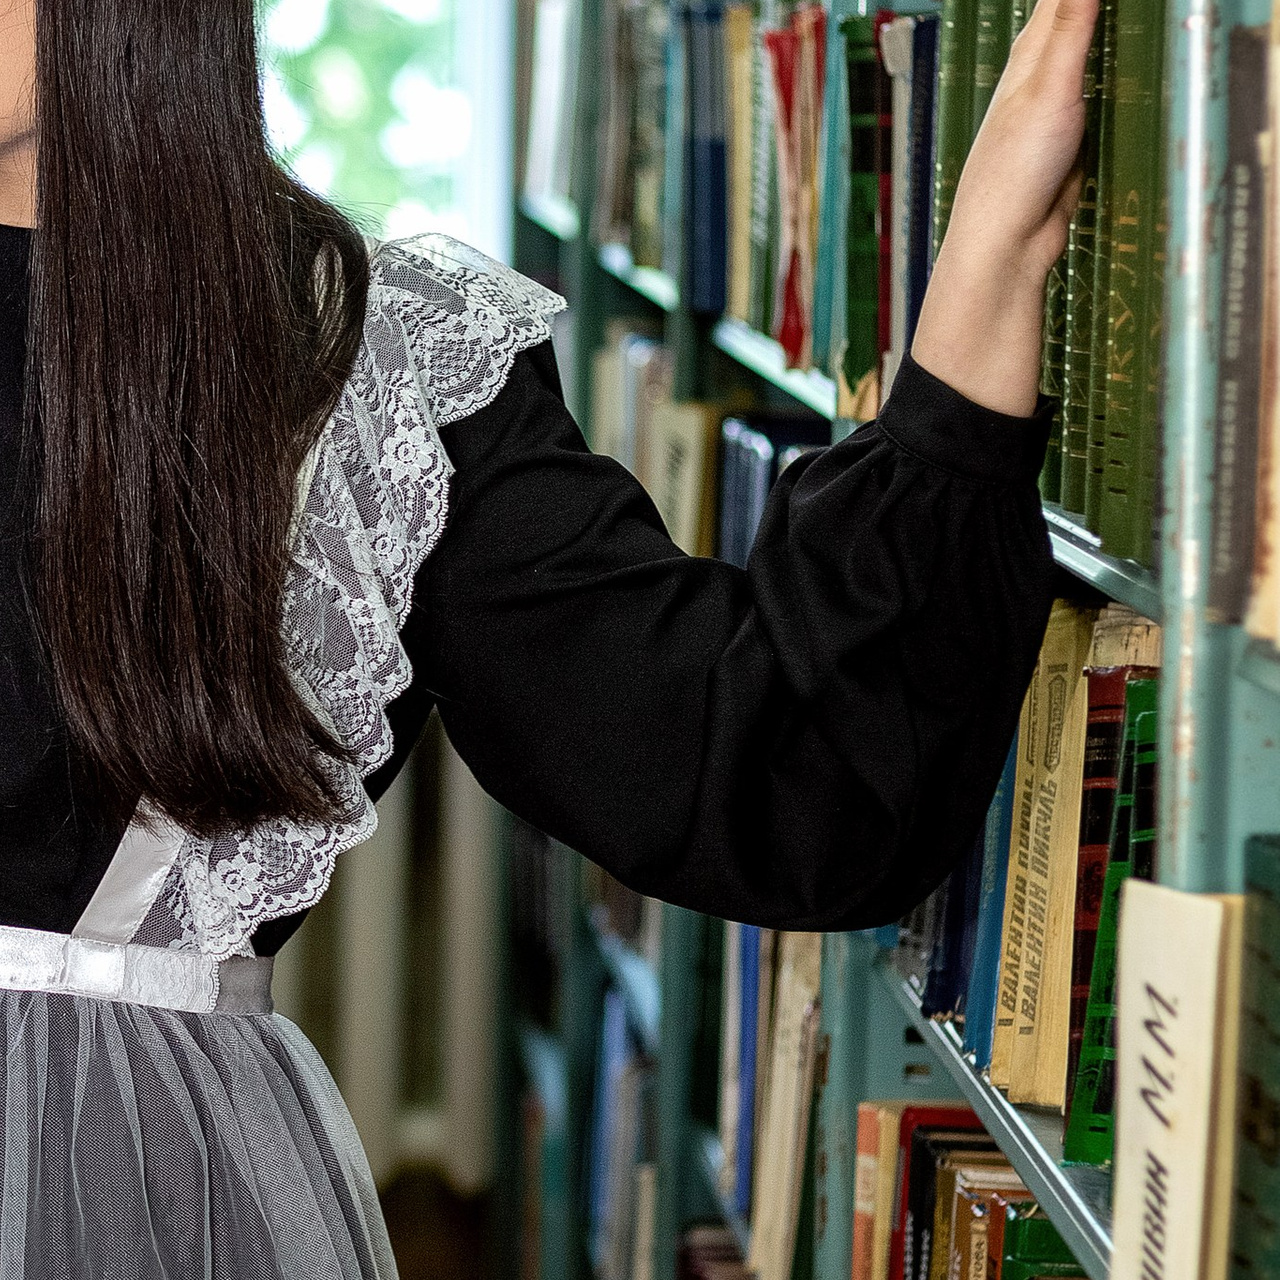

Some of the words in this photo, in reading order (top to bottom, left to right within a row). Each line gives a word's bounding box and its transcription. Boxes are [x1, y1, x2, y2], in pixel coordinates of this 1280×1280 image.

[1030, 779, 1057, 878] ПИКУЛЬ
[1000, 875, 1027, 1014] ВАЛЕНТИН
[1020, 880, 1048, 1022] ВАЛЕНТИН
